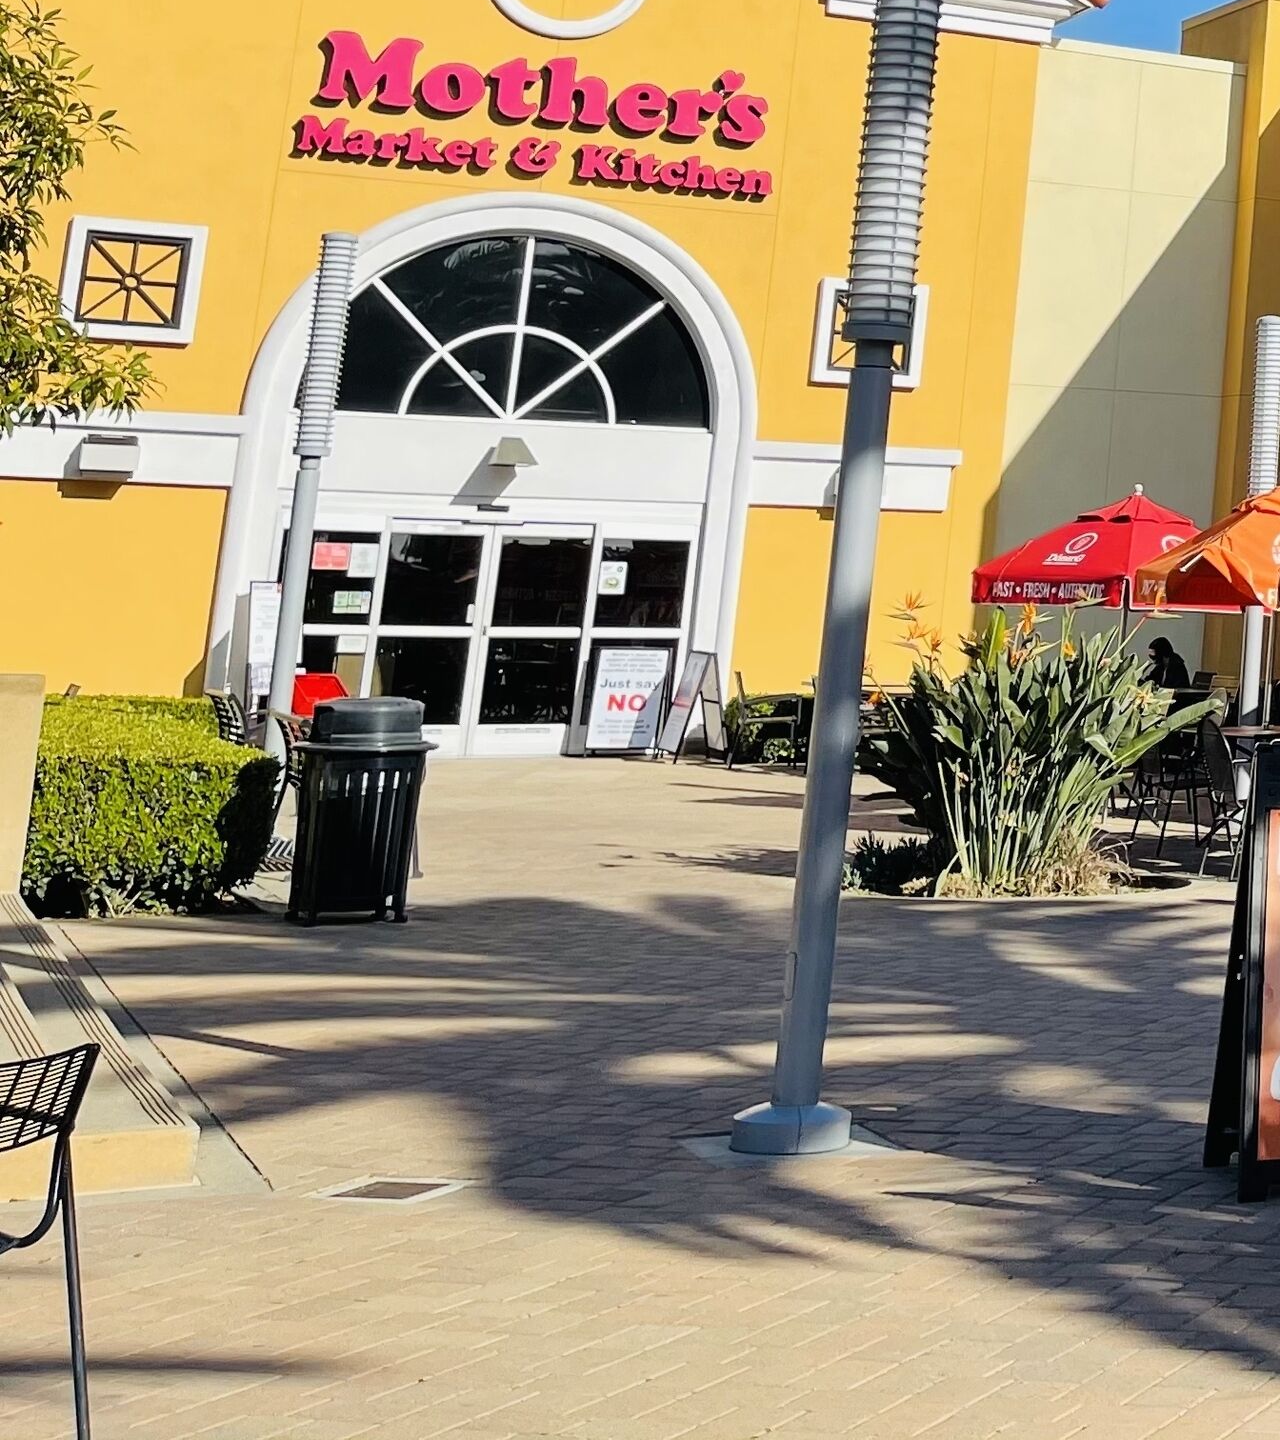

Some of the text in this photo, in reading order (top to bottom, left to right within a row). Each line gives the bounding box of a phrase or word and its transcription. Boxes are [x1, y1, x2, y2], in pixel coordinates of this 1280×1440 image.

[318, 29, 770, 145] Mother's
[298, 115, 773, 198] Market & Kitchen
[992, 581, 1015, 597] FAST
[1022, 581, 1051, 598] FRESH
[600, 678, 662, 692] Just say
[607, 693, 649, 712] NO
